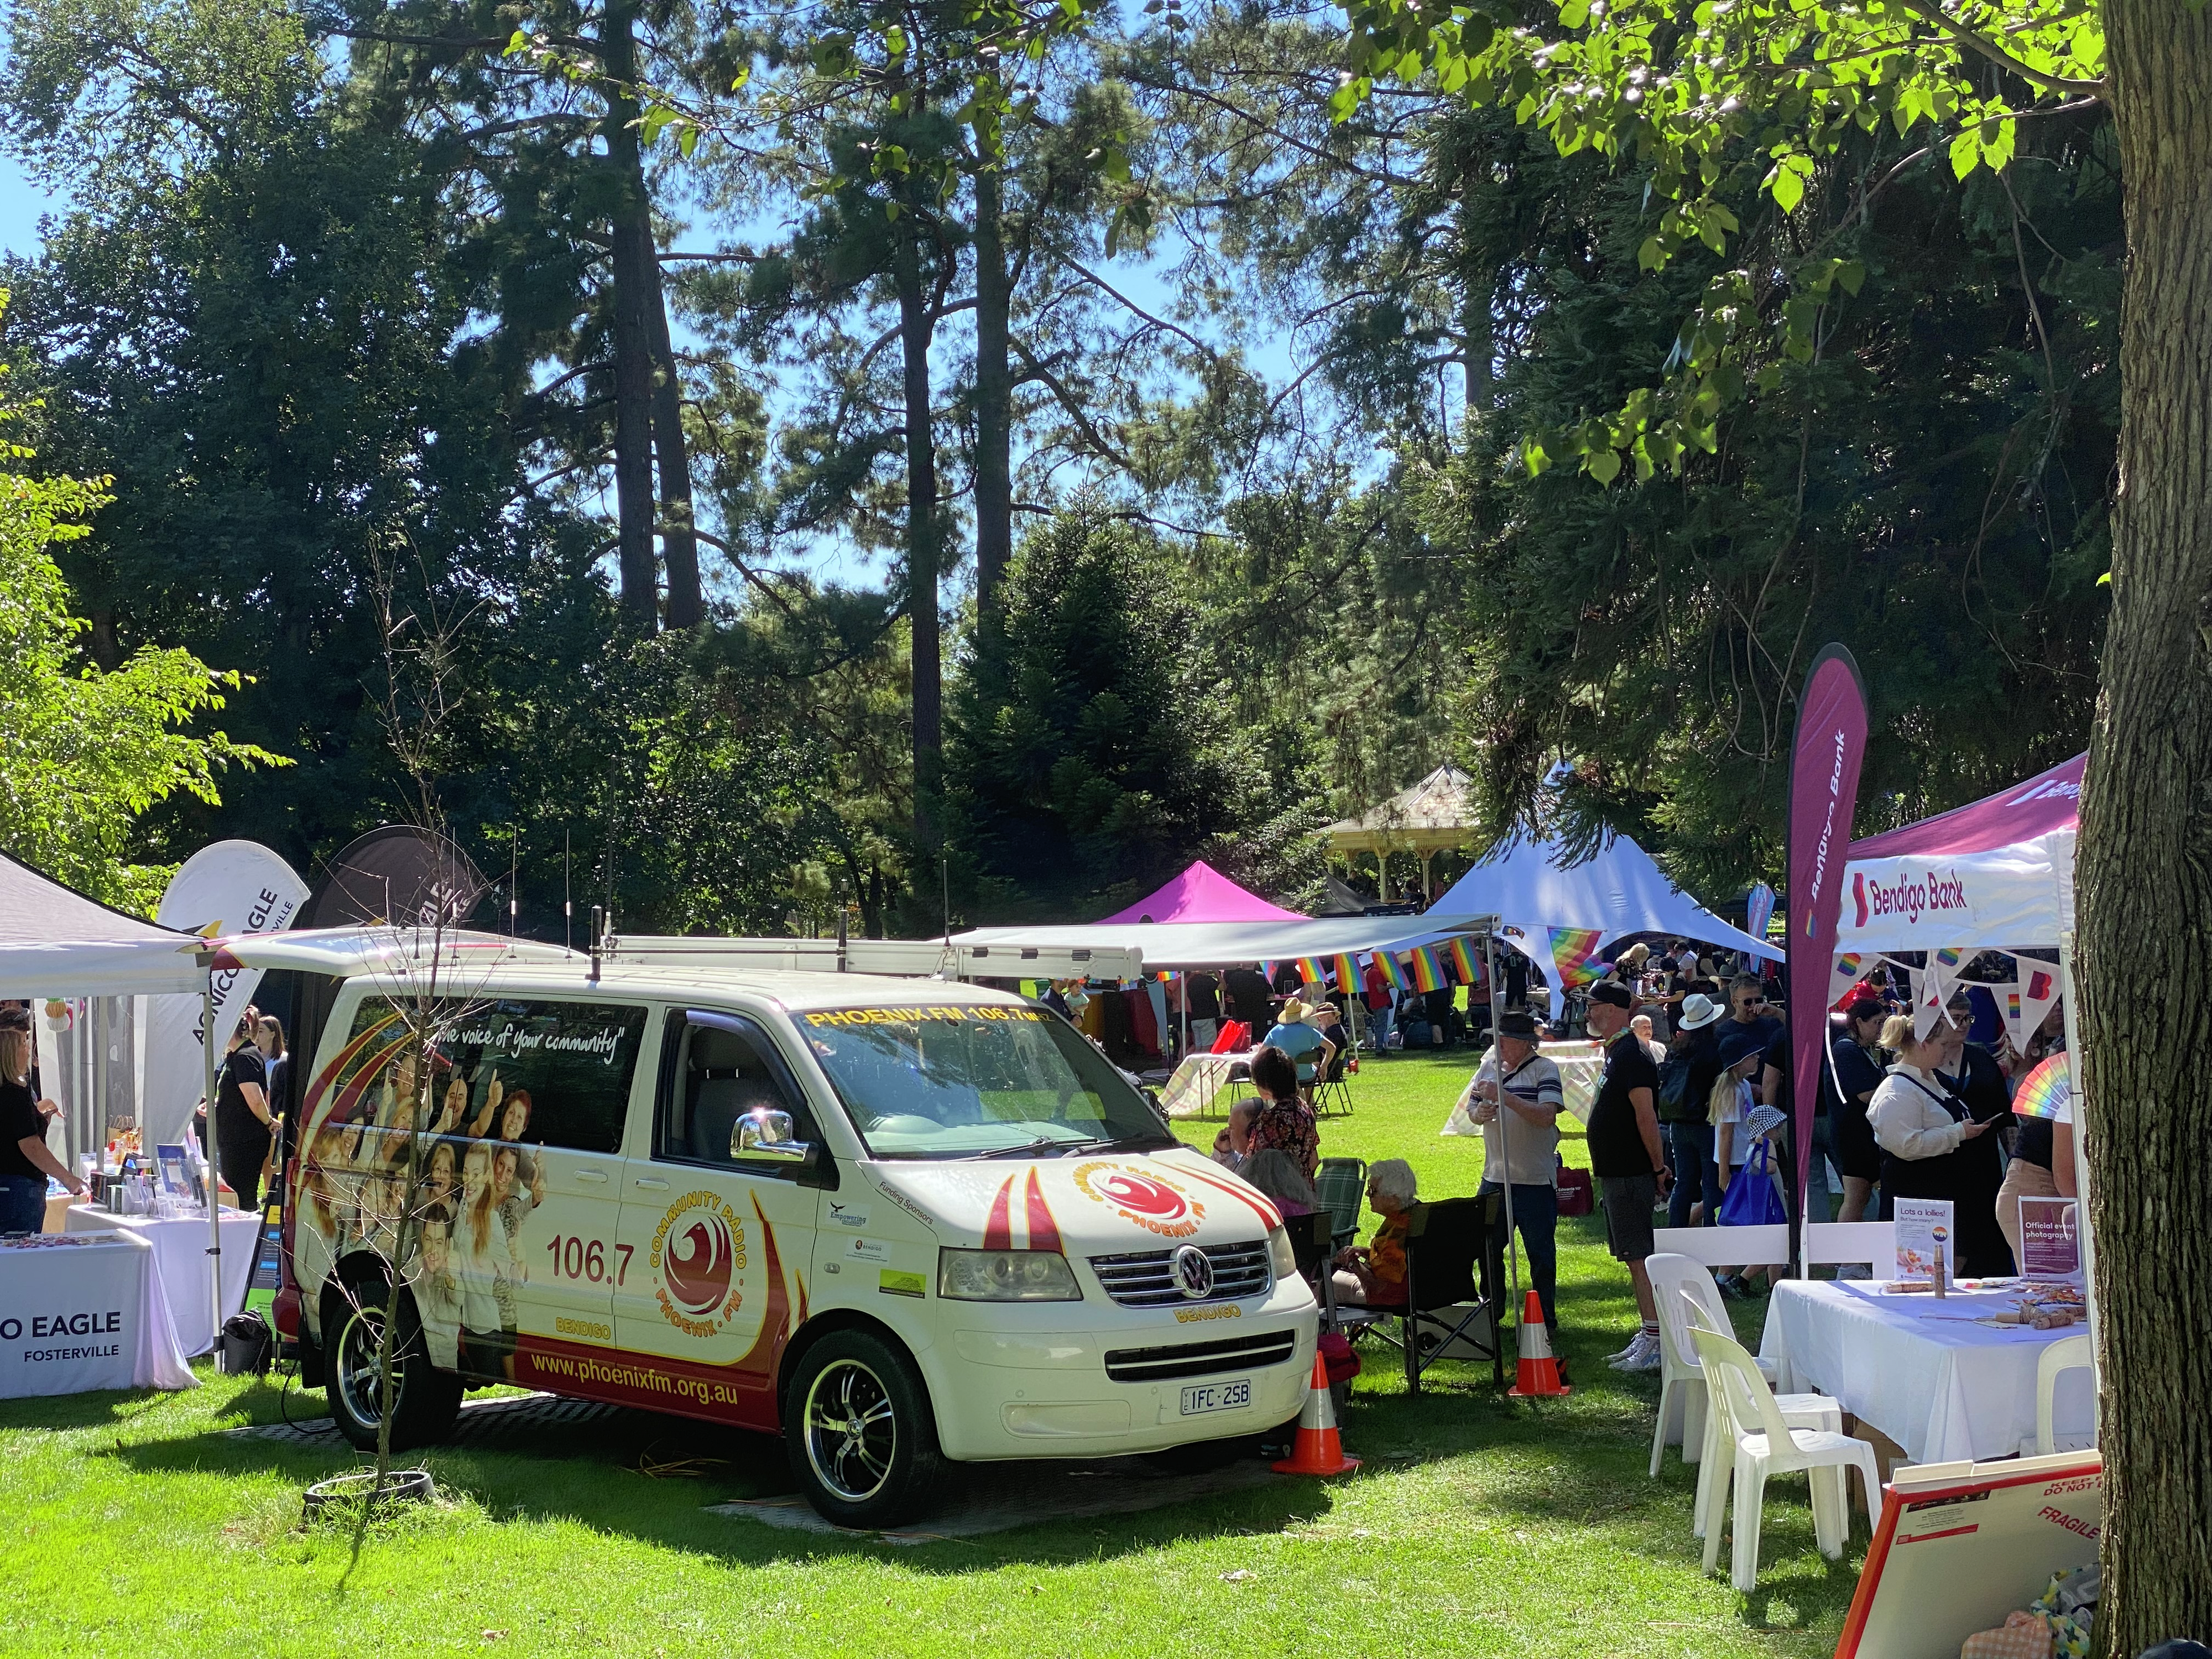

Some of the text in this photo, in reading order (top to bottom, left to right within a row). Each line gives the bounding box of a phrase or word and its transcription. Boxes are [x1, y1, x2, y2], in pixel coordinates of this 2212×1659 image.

[1830, 728, 1845, 797] Bank
[1869, 868, 1968, 924] Bendigo Bank
[805, 1008, 930, 1027] PHOENIX
[925, 1007, 968, 1021] FM
[461, 1024, 494, 1045] voice
[495, 1022, 514, 1049] of
[513, 1029, 544, 1059] your
[544, 1026, 626, 1065] community"
[1073, 1161, 1186, 1202] COMMUNITY RADIO
[830, 1211, 867, 1224] Empowering
[879, 1181, 934, 1225] Funding Sponsors
[1118, 1201, 1206, 1238] PHOENIX FM
[1925, 1209, 1946, 1217] lollies!
[649, 1190, 747, 1270] COMMUNITY RADIO
[2025, 1231, 2073, 1240] photography
[546, 1234, 635, 1287] 106.7
[32, 1311, 121, 1338] EAGLE
[555, 1317, 611, 1340] BENDIGO
[655, 1287, 743, 1338] PHOENIX FM
[1172, 1303, 1241, 1323] BENDIGO
[24, 1344, 119, 1362] FOSTERVILLE
[530, 1354, 739, 1406] www.phoenixfm.org.au
[2043, 1486, 2063, 1496] DO
[2066, 1481, 2095, 1493] NOT
[2050, 1478, 2091, 1488] KEEP
[2037, 1505, 2101, 1540] FRAGILE
